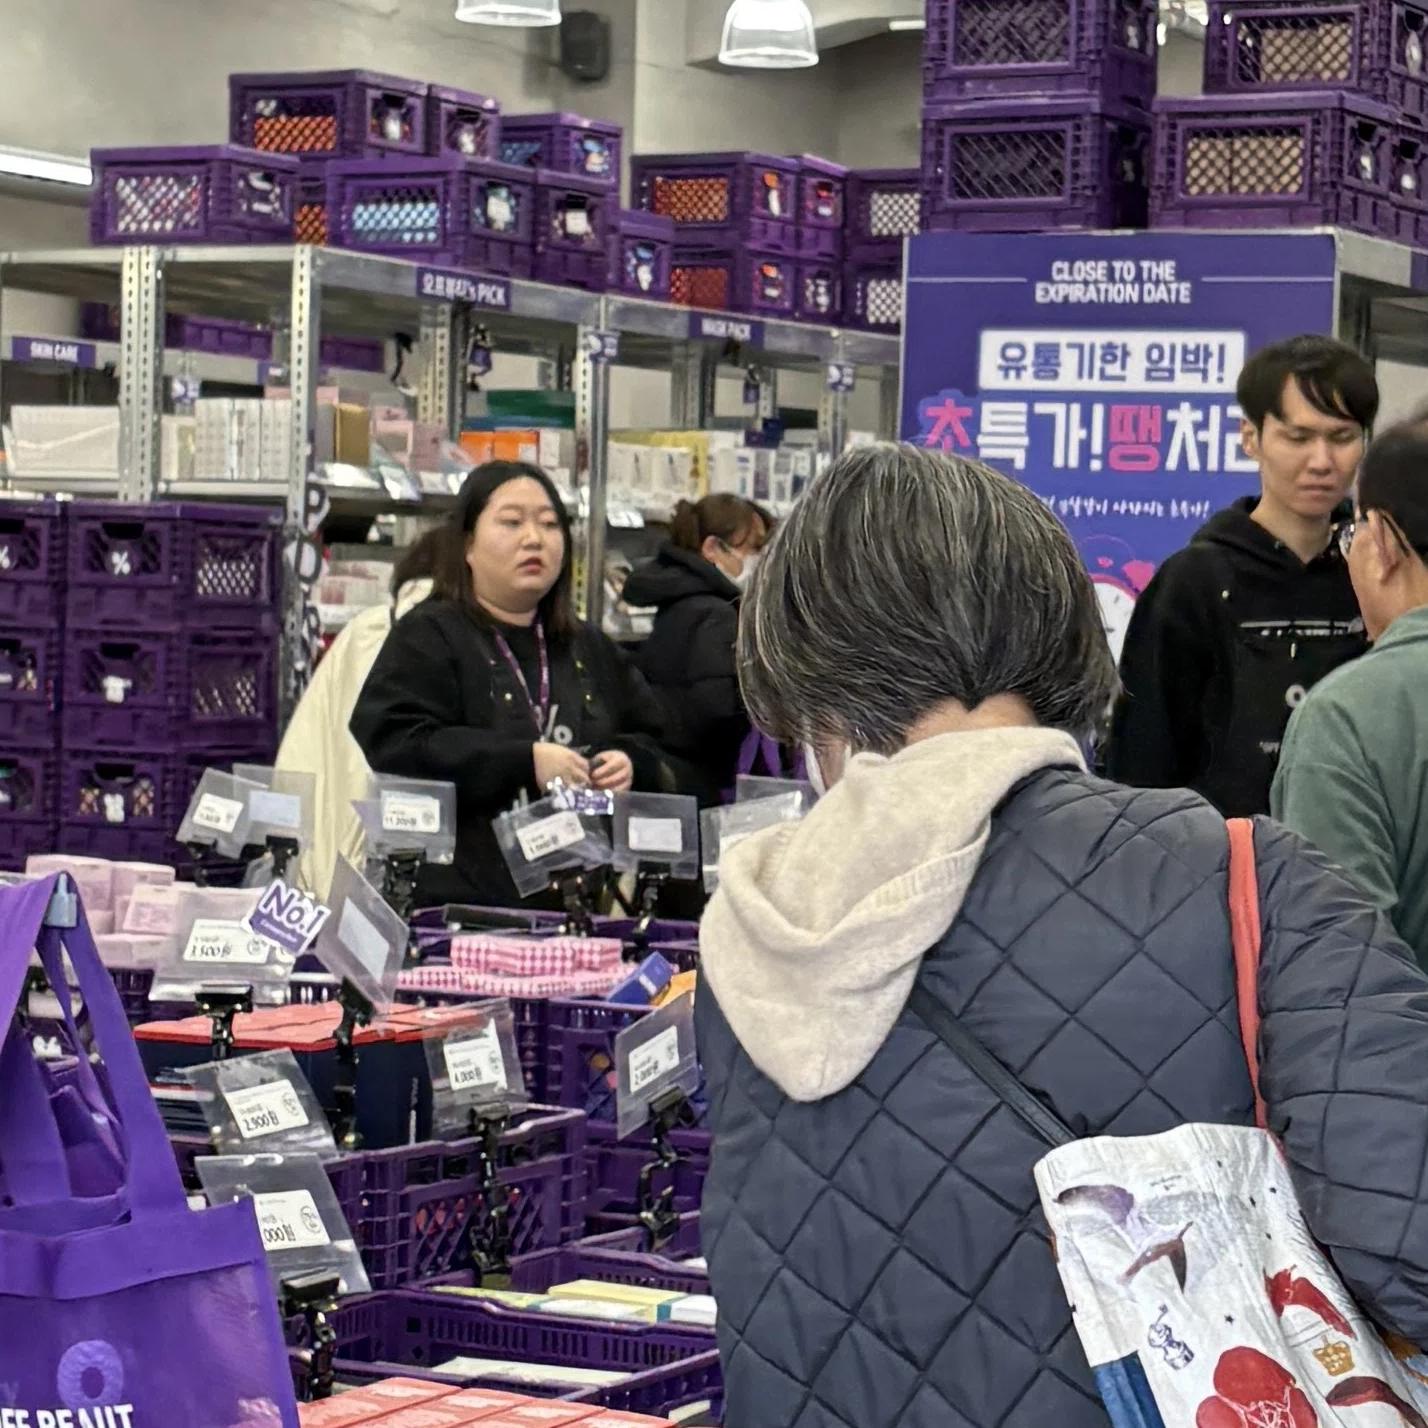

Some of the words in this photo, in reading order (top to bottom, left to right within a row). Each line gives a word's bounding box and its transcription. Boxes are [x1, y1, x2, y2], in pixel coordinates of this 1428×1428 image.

[1051, 261, 1107, 282] CLOSE
[1112, 261, 1136, 281] TO
[1142, 260, 1176, 281] THE
[1035, 282, 1140, 305] EXPIRATION
[1143, 282, 1192, 304] DATE
[996, 341, 1132, 383] 유통기한
[1144, 341, 1226, 384] 임박!
[260, 882, 327, 935] No.1
